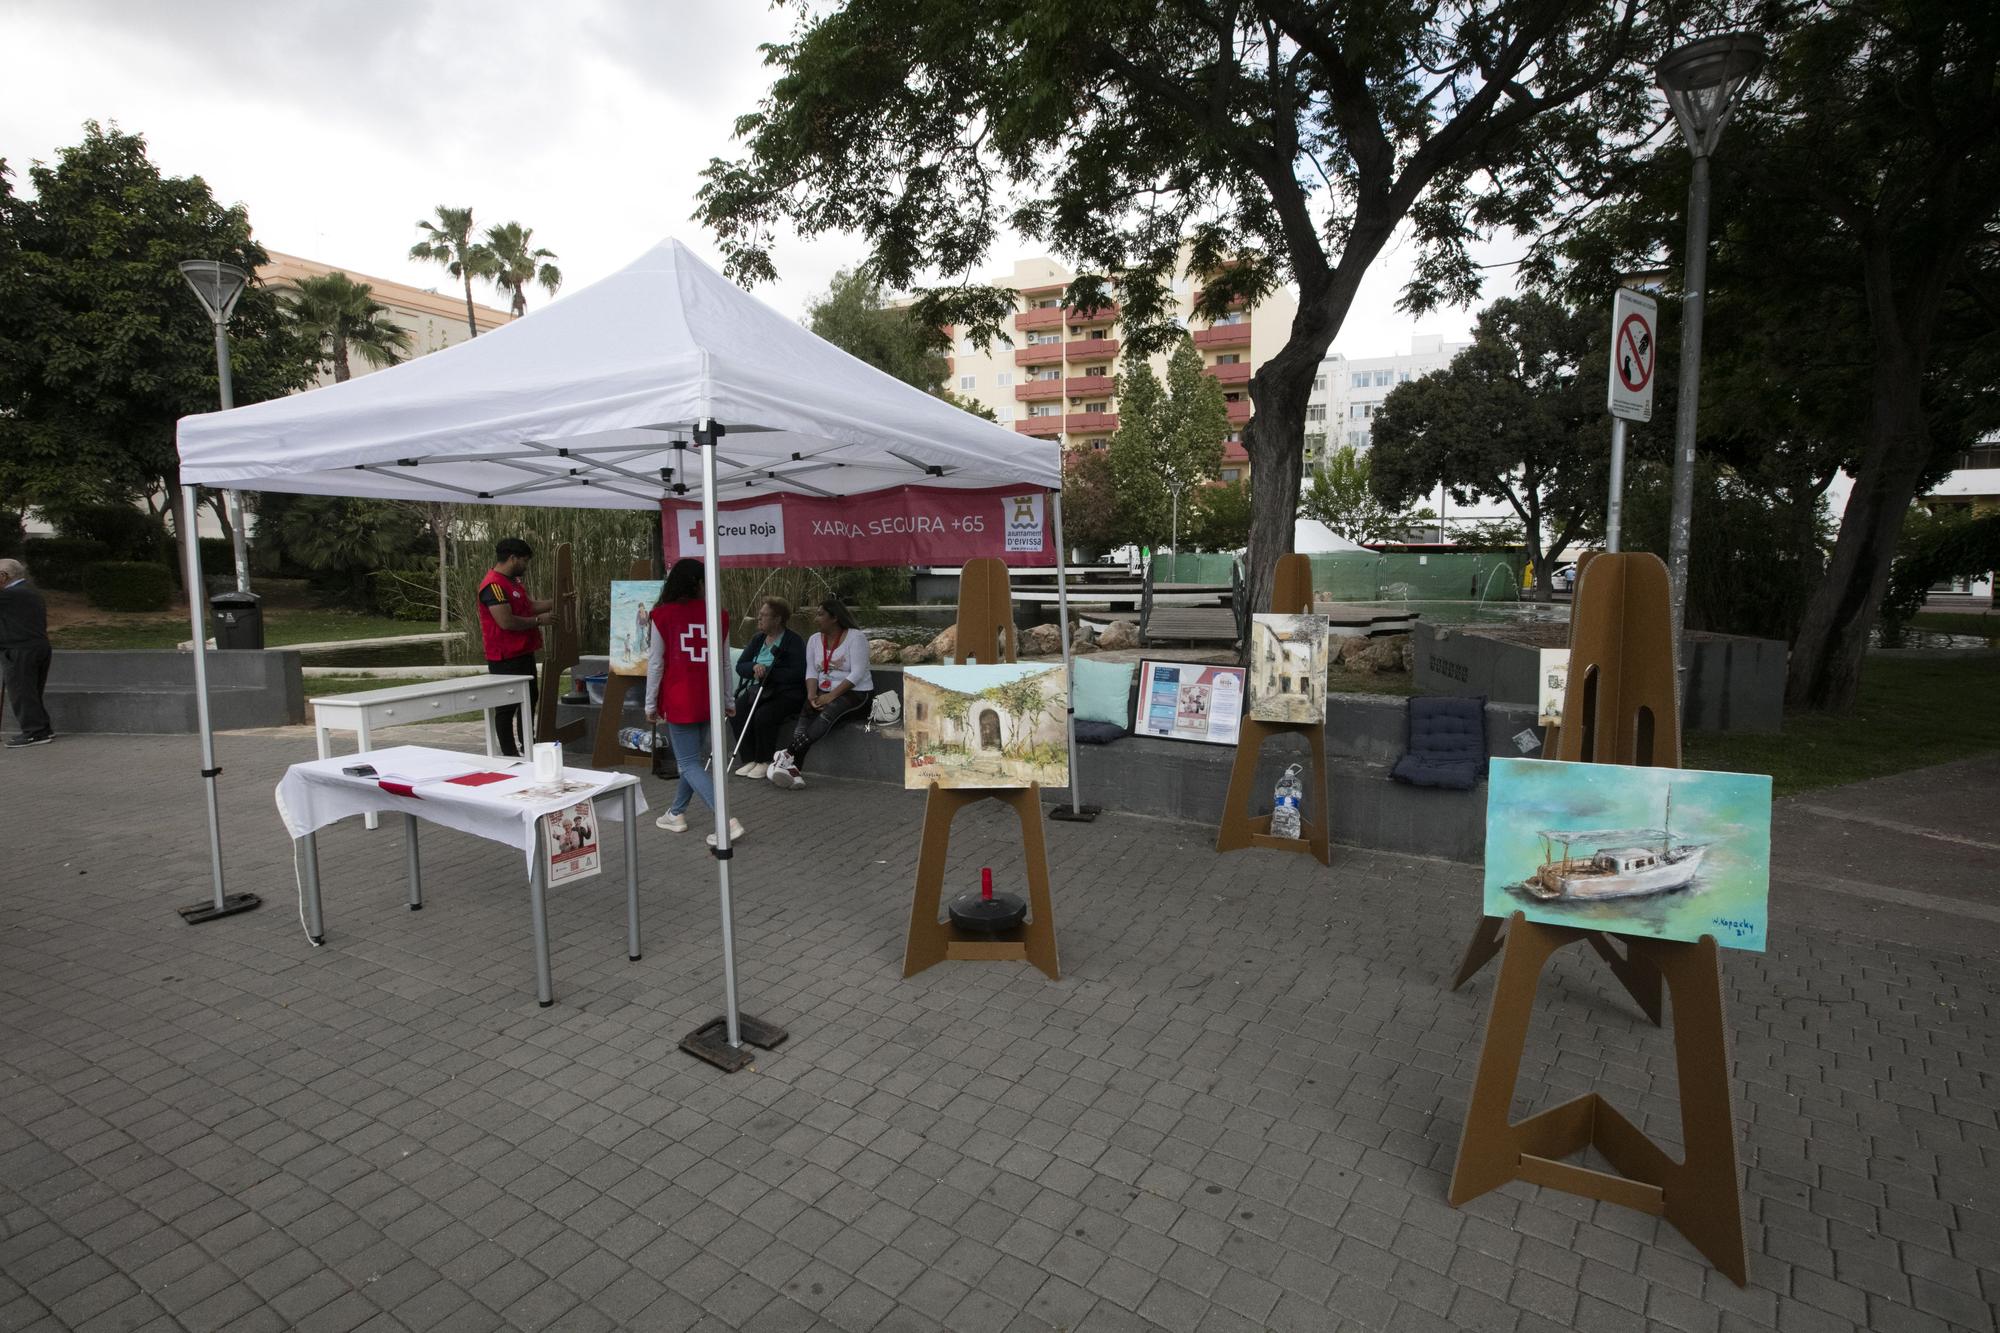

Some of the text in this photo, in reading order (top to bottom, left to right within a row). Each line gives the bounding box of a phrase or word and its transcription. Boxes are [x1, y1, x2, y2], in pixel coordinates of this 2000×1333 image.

[717, 522, 776, 537] Creu Roja
[812, 515, 985, 538] XARXA SEGURA +65
